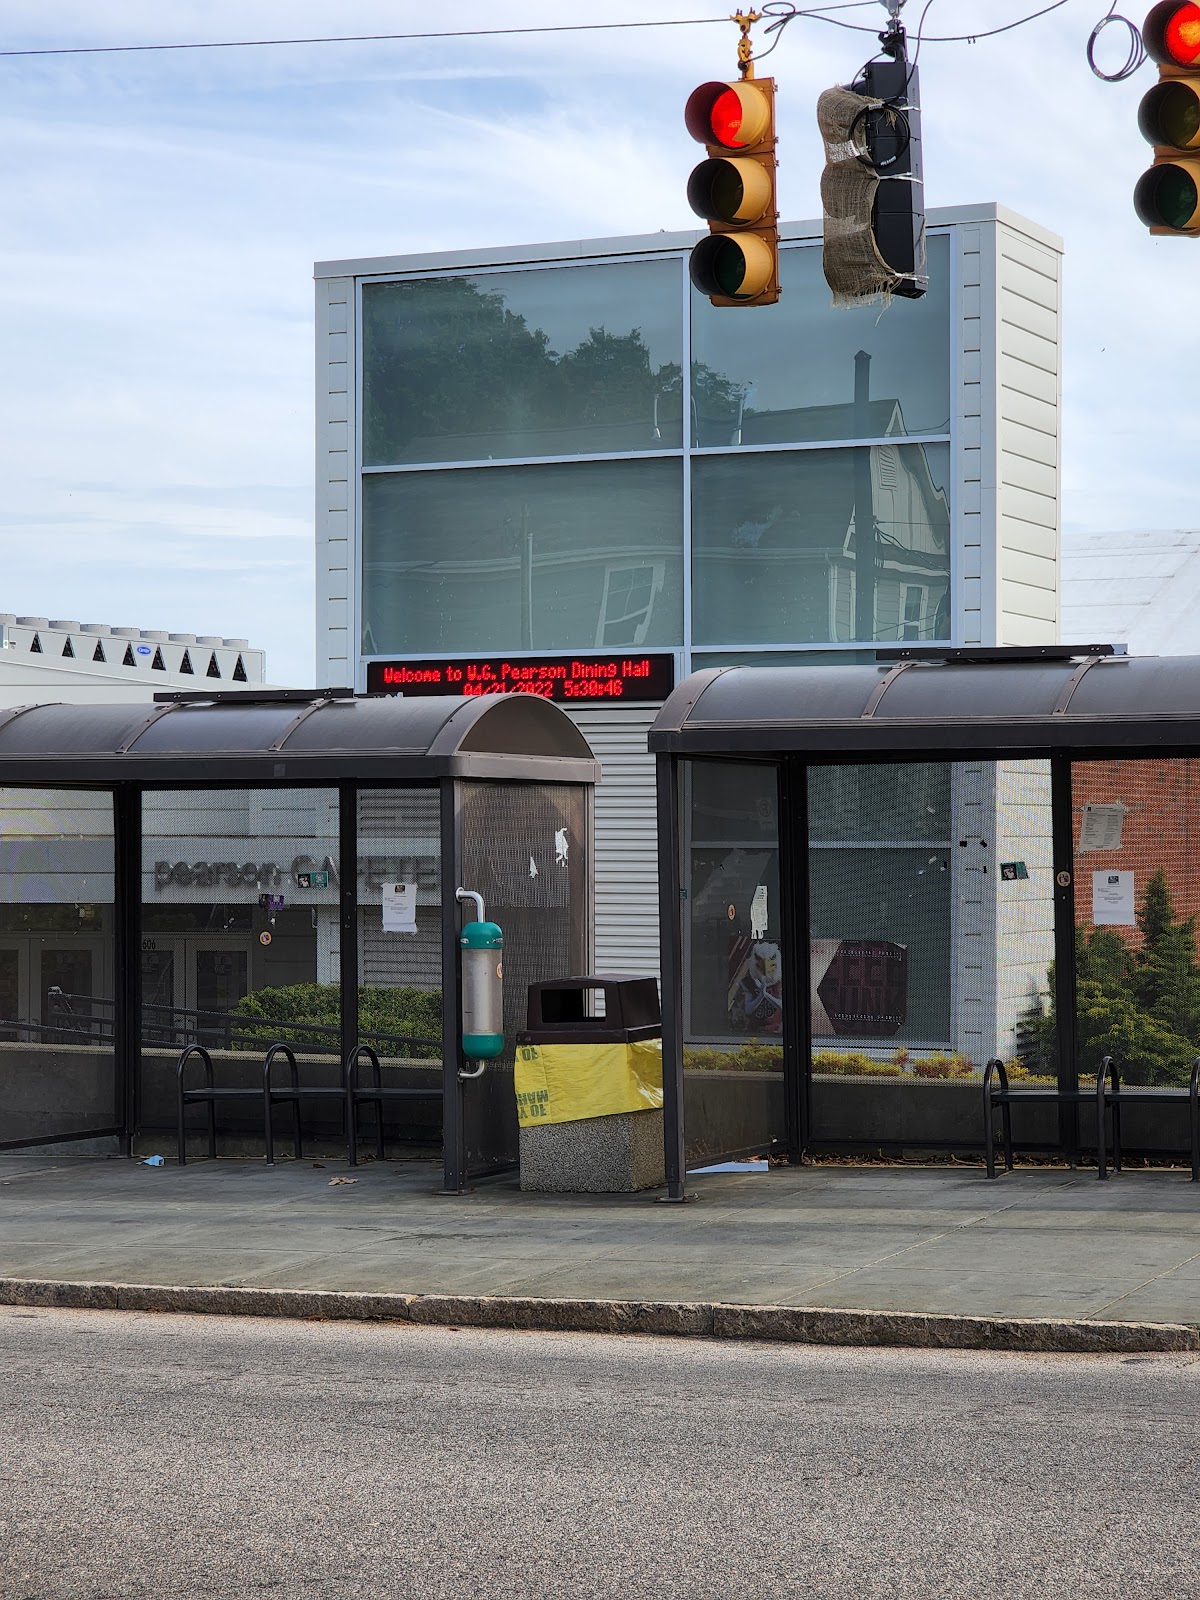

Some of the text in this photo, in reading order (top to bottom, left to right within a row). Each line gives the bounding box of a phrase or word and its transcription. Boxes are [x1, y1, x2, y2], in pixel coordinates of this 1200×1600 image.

[383, 667, 441, 683] Welcome
[447, 665, 463, 682] to
[501, 663, 567, 679] Pearson
[571, 661, 617, 678] Dining
[622, 660, 650, 677] Hall
[463, 680, 623, 697] 04/21/2022 5:30:46
[154, 861, 283, 891] pearson
